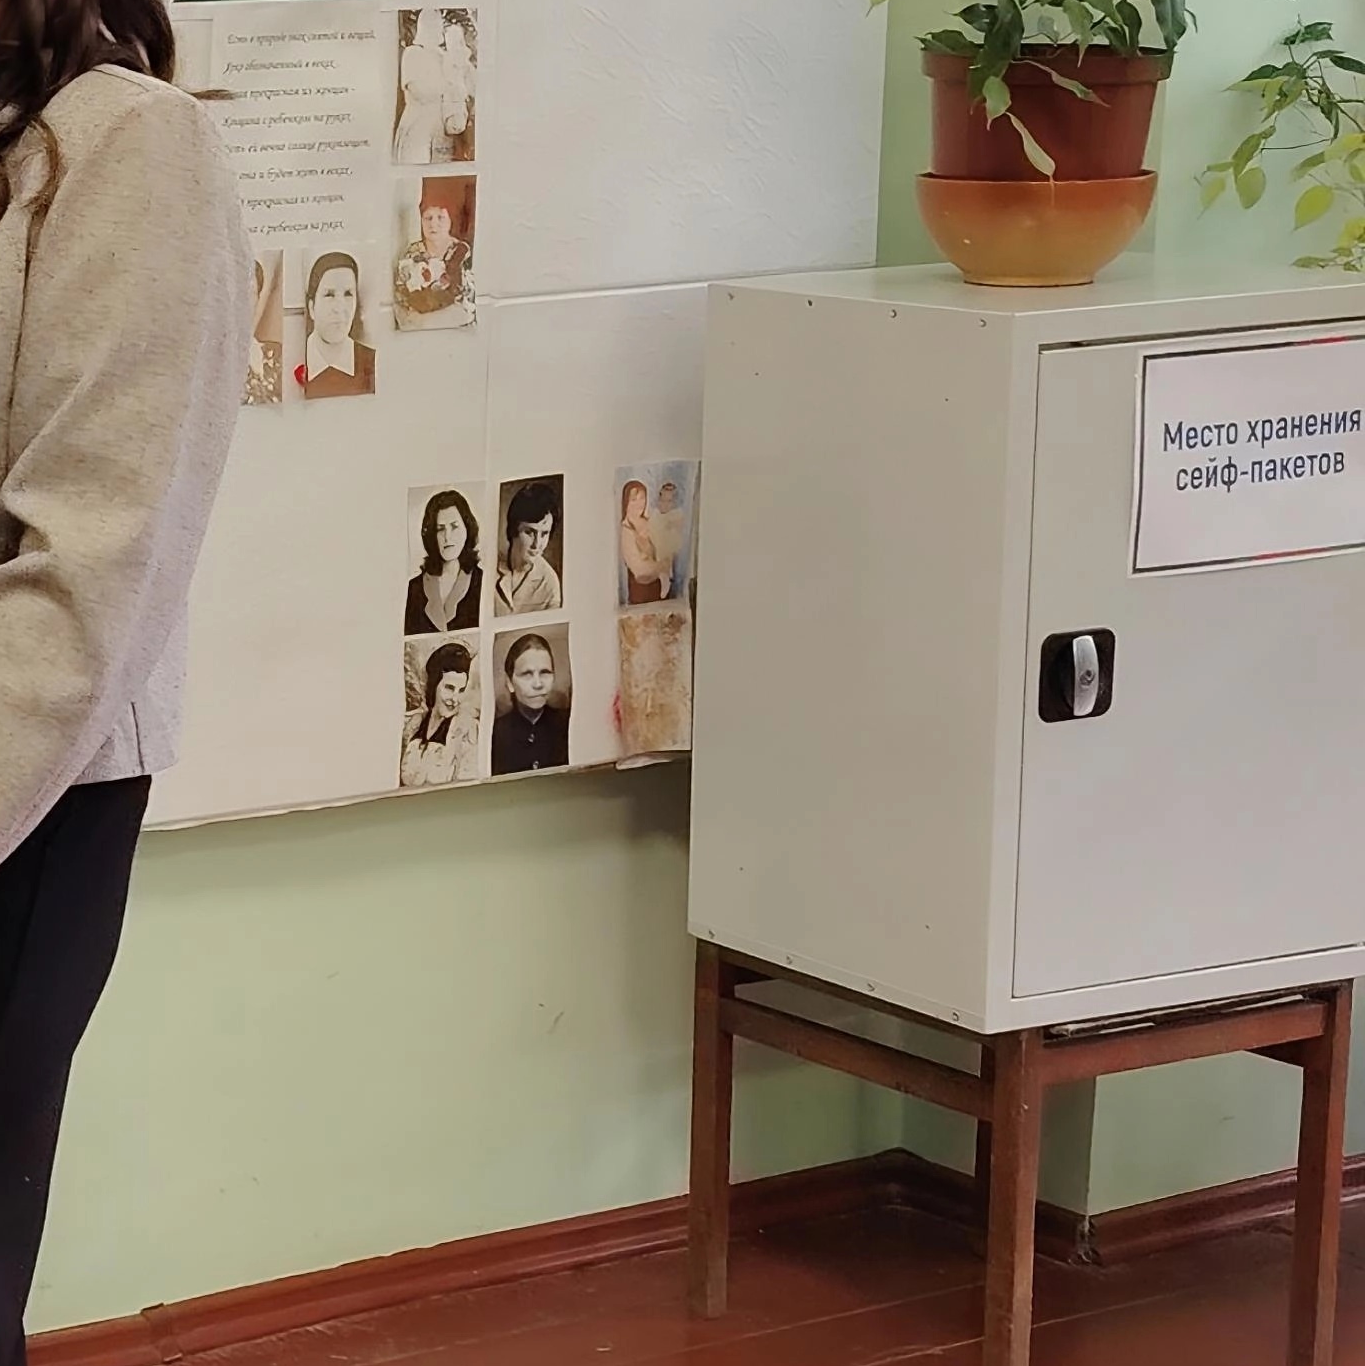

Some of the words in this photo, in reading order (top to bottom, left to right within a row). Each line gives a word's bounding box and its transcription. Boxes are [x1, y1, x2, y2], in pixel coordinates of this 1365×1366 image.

[1163, 421, 1239, 452] Место
[1246, 409, 1363, 448] хранения
[1176, 451, 1345, 492] сейф-пакетов
